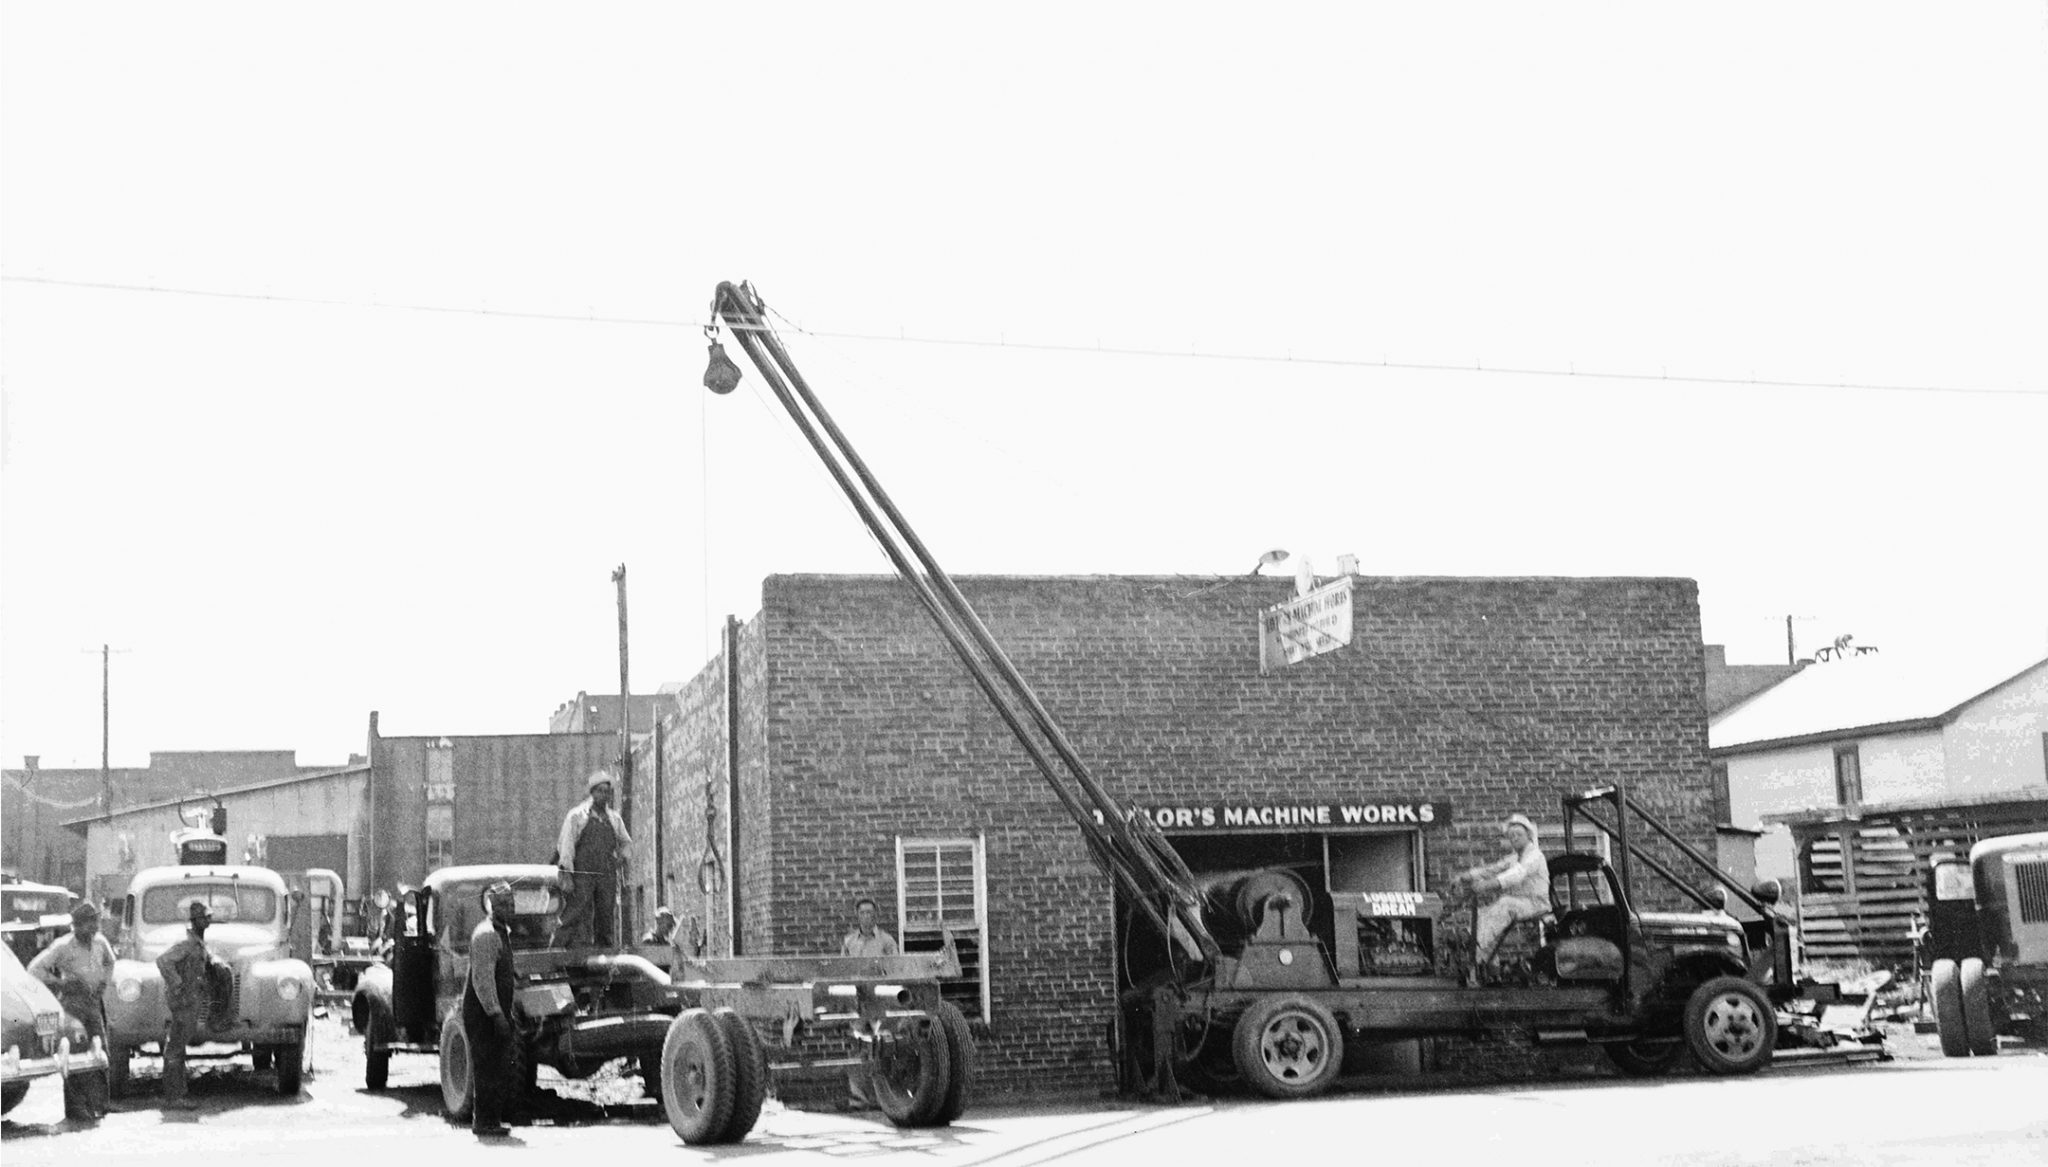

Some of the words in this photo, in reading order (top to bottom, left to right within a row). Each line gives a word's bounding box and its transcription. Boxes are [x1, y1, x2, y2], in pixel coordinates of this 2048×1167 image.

[1092, 806, 1216, 828] TOR'S
[1224, 805, 1331, 826] MACHINE
[1340, 803, 1435, 824] WORKS
[1371, 901, 1417, 916] DREAM
